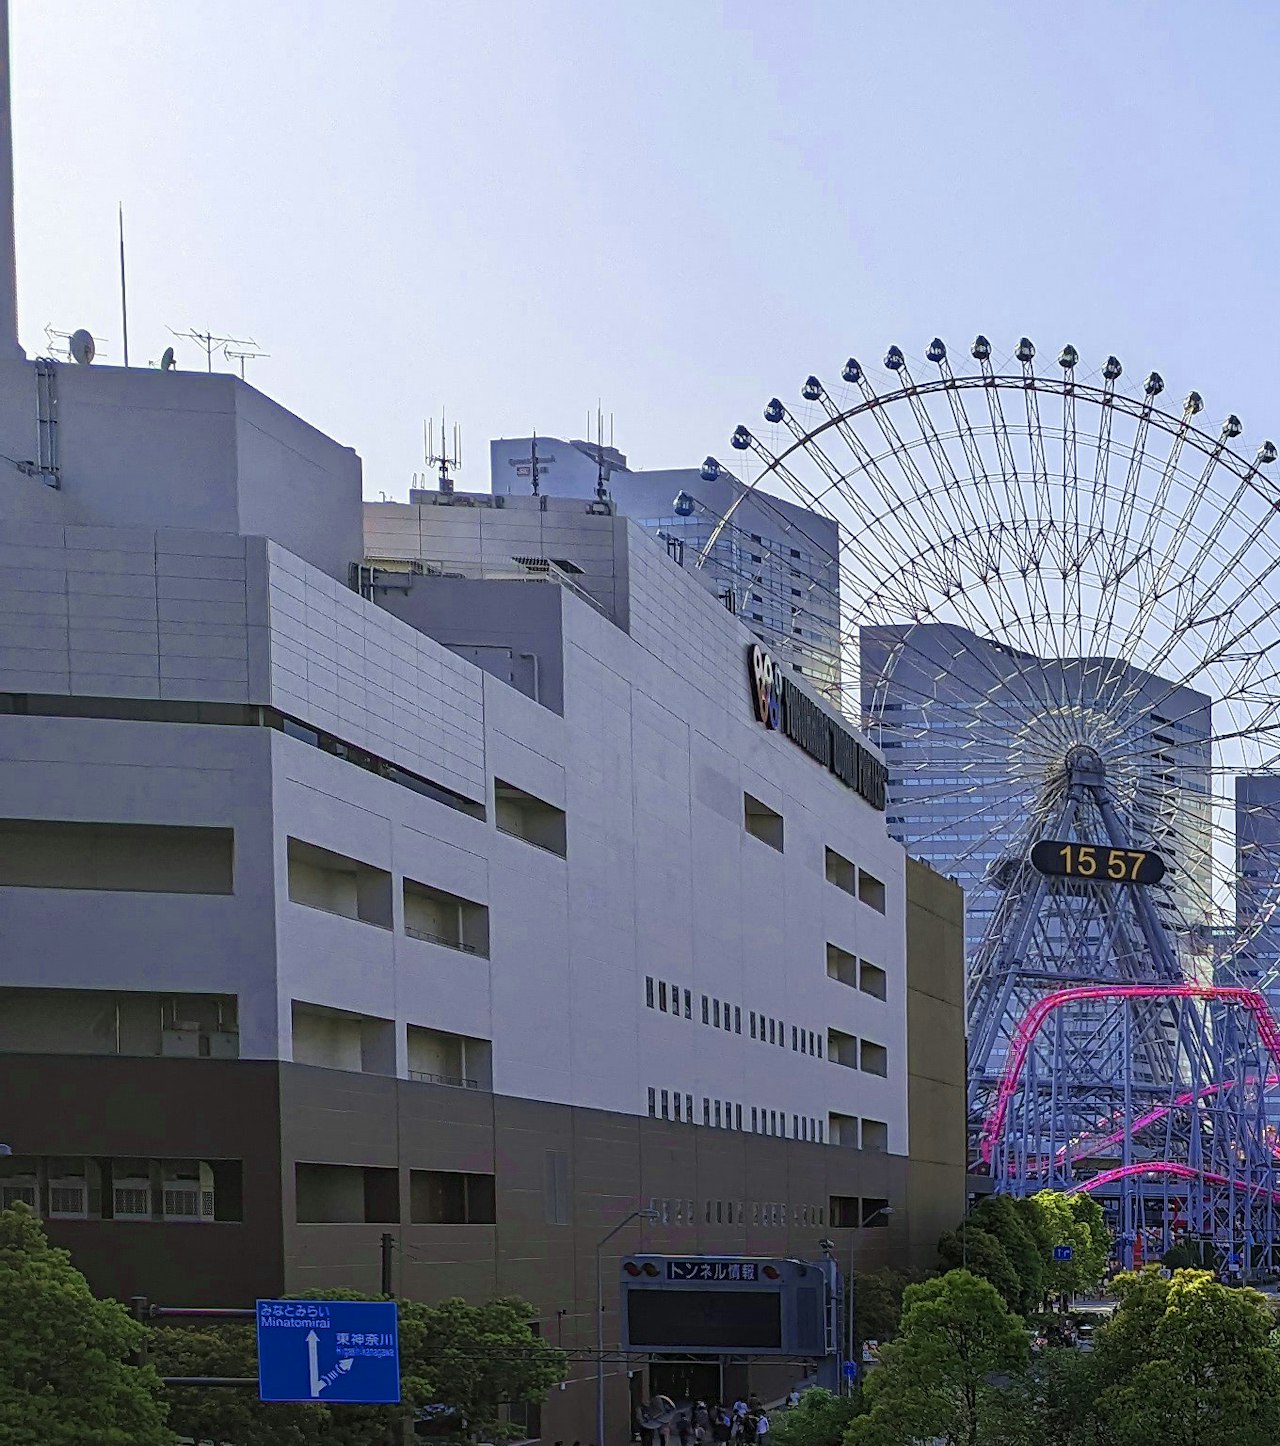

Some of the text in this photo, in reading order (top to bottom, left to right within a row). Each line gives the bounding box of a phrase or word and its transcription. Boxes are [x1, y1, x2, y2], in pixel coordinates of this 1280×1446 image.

[1060, 844, 1147, 880] 15 57
[671, 1263, 755, 1280] トンネル情報
[260, 1303, 331, 1318] みなとみらい
[260, 1316, 331, 1329] Minatomirai
[336, 1332, 394, 1346] 東神奈川
